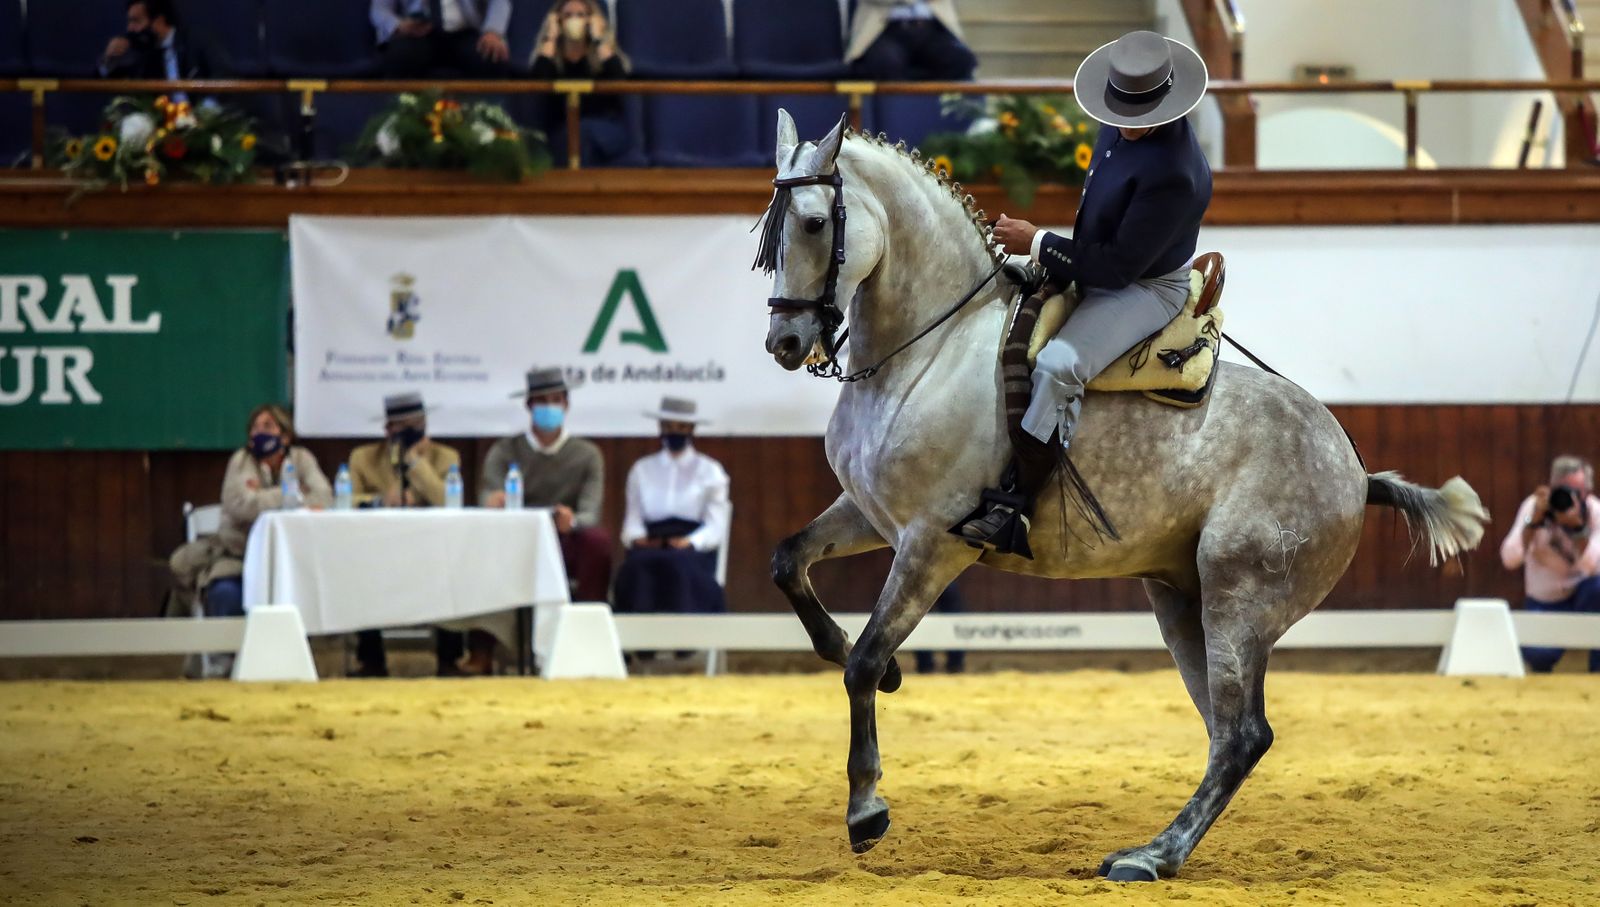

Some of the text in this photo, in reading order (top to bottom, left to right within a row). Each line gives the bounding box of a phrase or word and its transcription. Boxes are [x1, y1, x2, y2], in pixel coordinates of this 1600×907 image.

[0, 274, 162, 333] RAL
[591, 363, 615, 382] de
[622, 360, 725, 382] Andalucía
